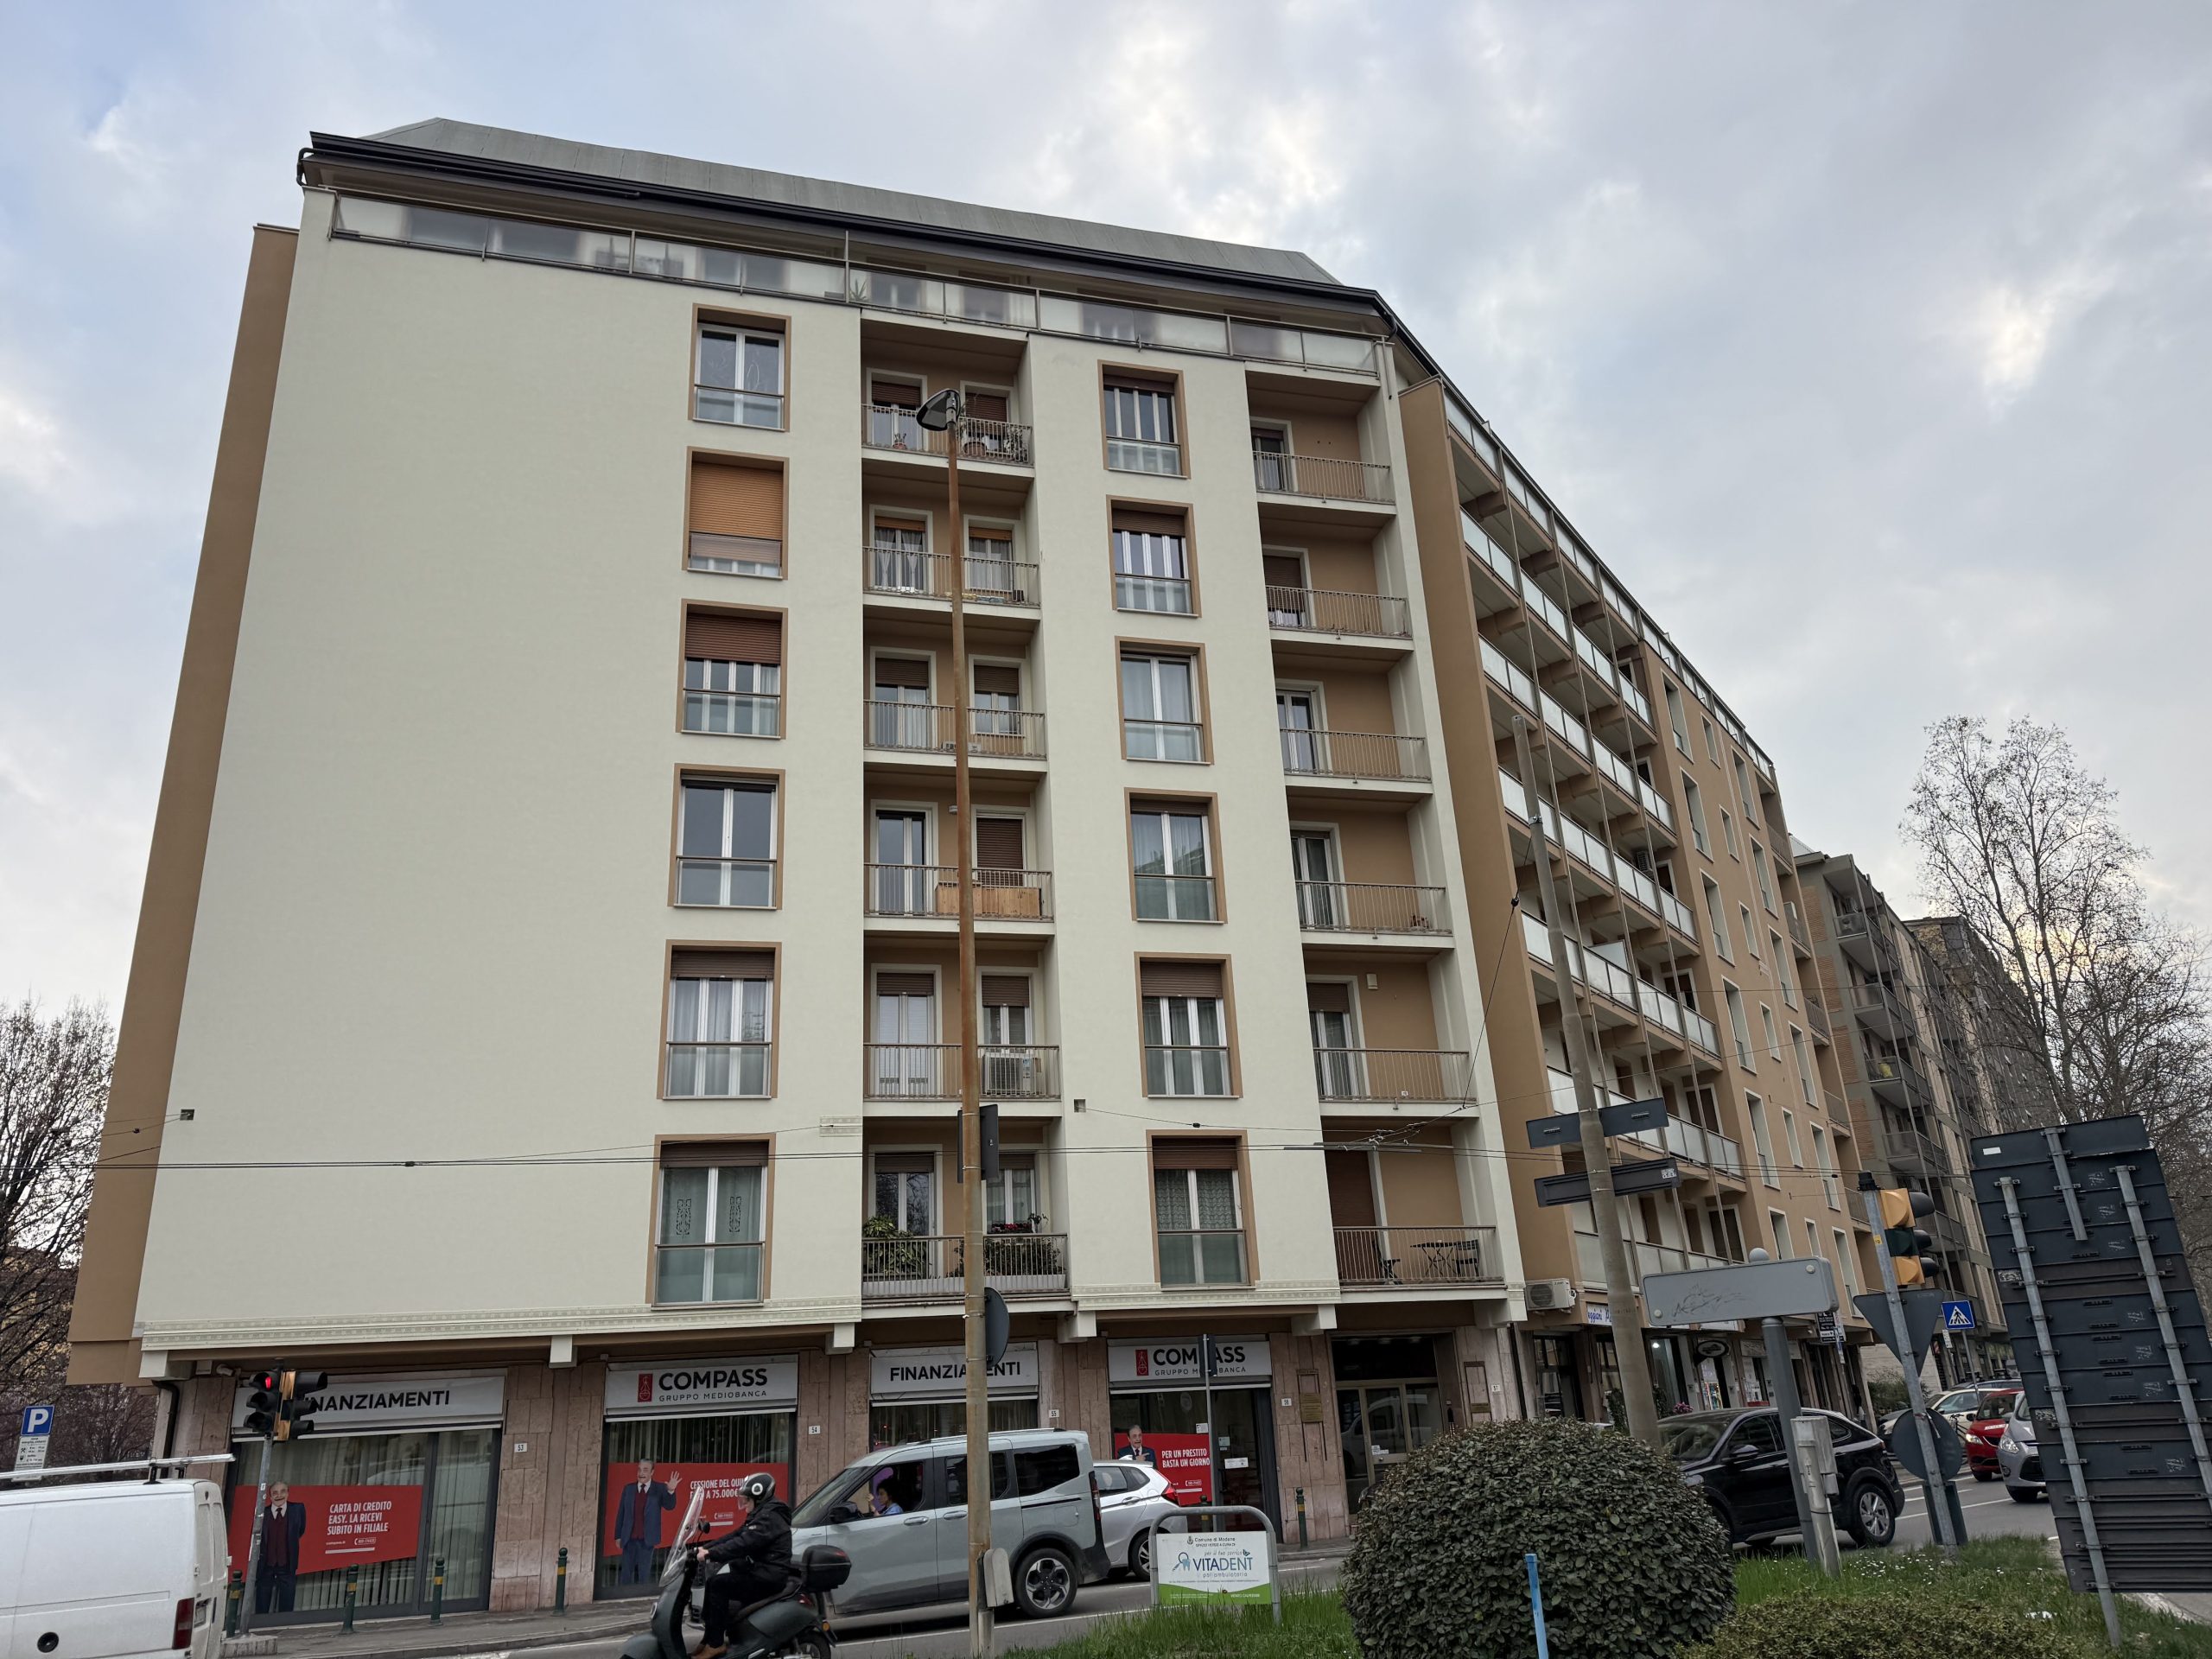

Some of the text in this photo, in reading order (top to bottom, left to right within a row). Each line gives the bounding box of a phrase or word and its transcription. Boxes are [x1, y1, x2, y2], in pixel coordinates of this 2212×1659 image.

[1153, 1346, 1245, 1365] COMASS
[890, 1362, 1020, 1381] FINANZIAENTI
[658, 1368, 768, 1391] COMPASS
[305, 1390, 450, 1411] NANZIAMENTI
[658, 1390, 767, 1402] GRUPPO MEDIOBANCA
[27, 1408, 49, 1433] P
[1161, 1450, 1173, 1459] PER
[1182, 1448, 1207, 1458] PRESTITO
[1162, 1458, 1210, 1468] BASTA UN GIORNO
[719, 1478, 729, 1488] DEL
[706, 1491, 711, 1499] A
[329, 1501, 392, 1514] CARTA DI CREDITO
[328, 1512, 383, 1524] EASY. LA RICEVI
[327, 1522, 389, 1535] SUBITO IN FILIALE
[1192, 1557, 1253, 1572] VITADENT
